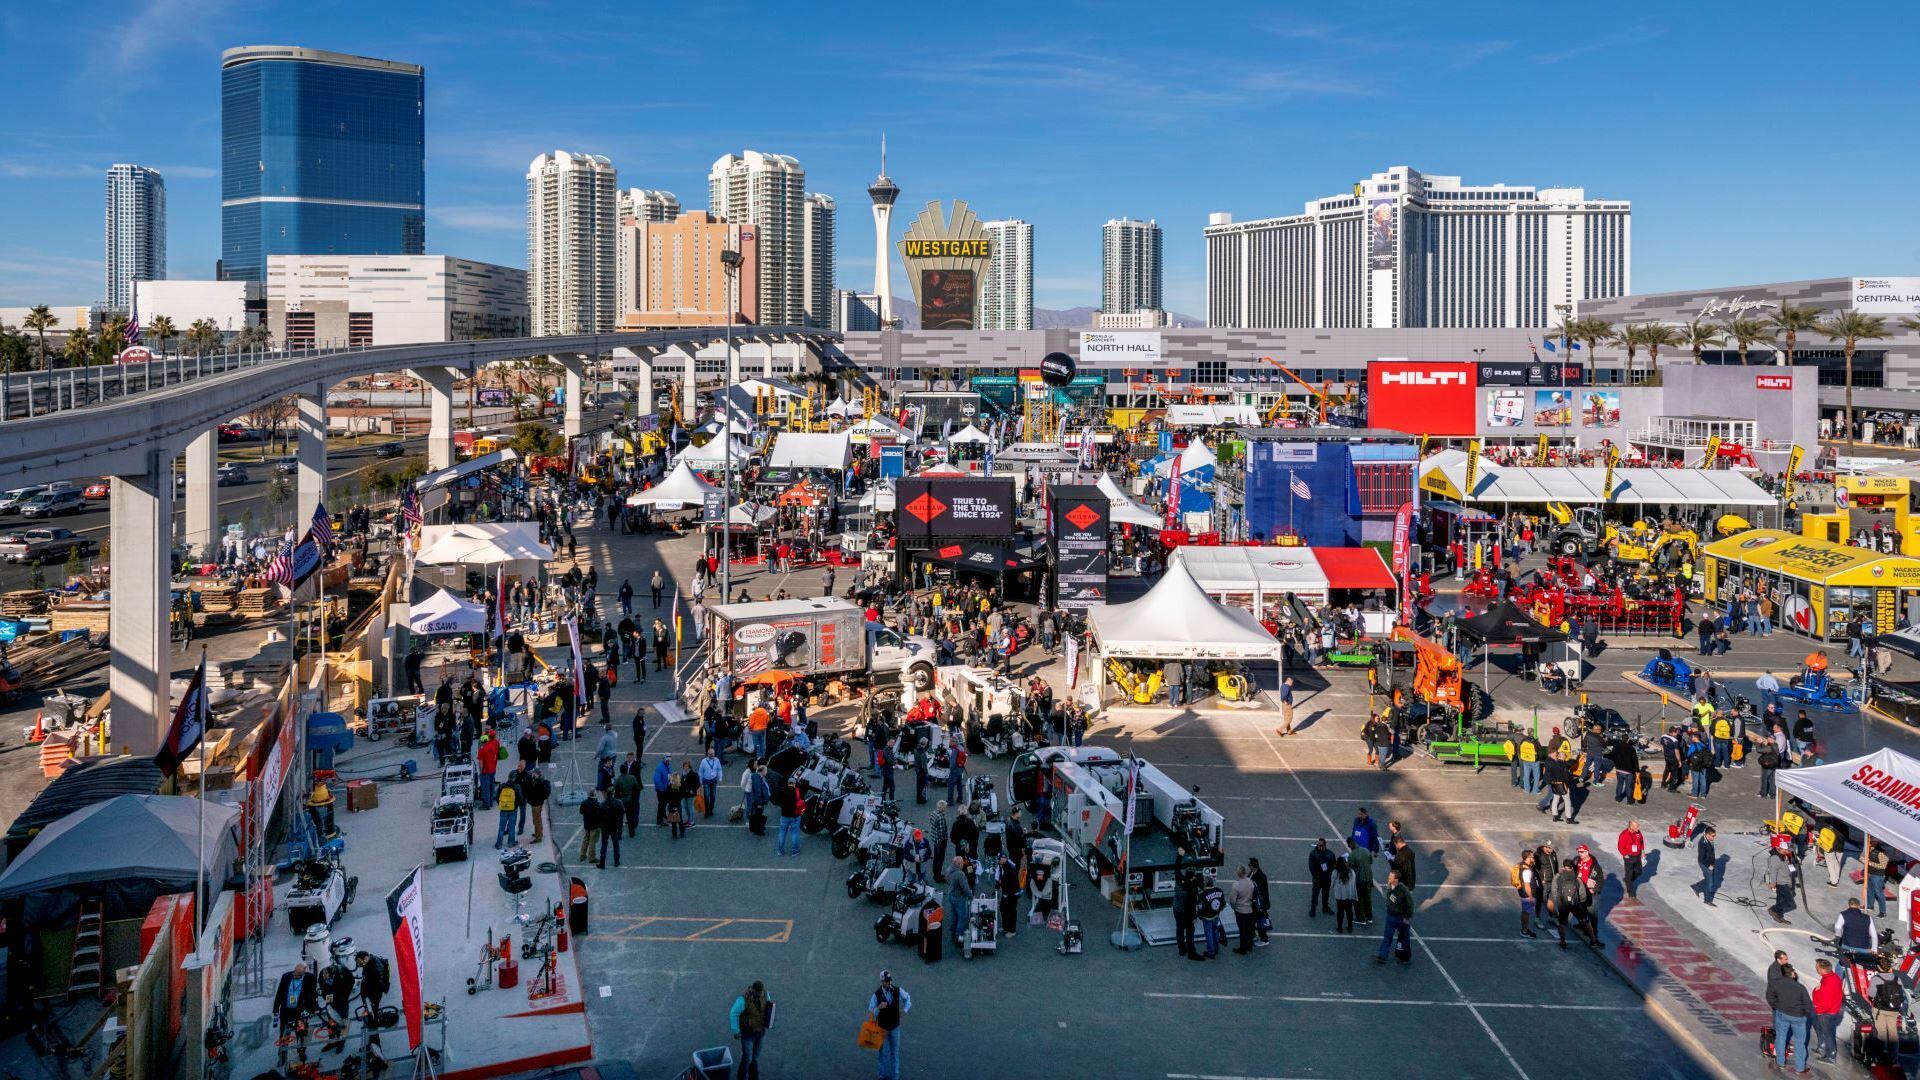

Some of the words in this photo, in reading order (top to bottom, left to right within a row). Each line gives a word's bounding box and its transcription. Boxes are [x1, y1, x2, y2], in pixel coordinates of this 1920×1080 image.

[907, 241, 988, 256] WESTGATE
[1087, 344, 1124, 352] NORTH
[1127, 344, 1154, 352] HALL
[1382, 372, 1467, 385] HILTI
[1560, 368, 1580, 378] BOSCH
[1757, 378, 1790, 388] HILTI
[1775, 549, 1843, 568] NEUSON
